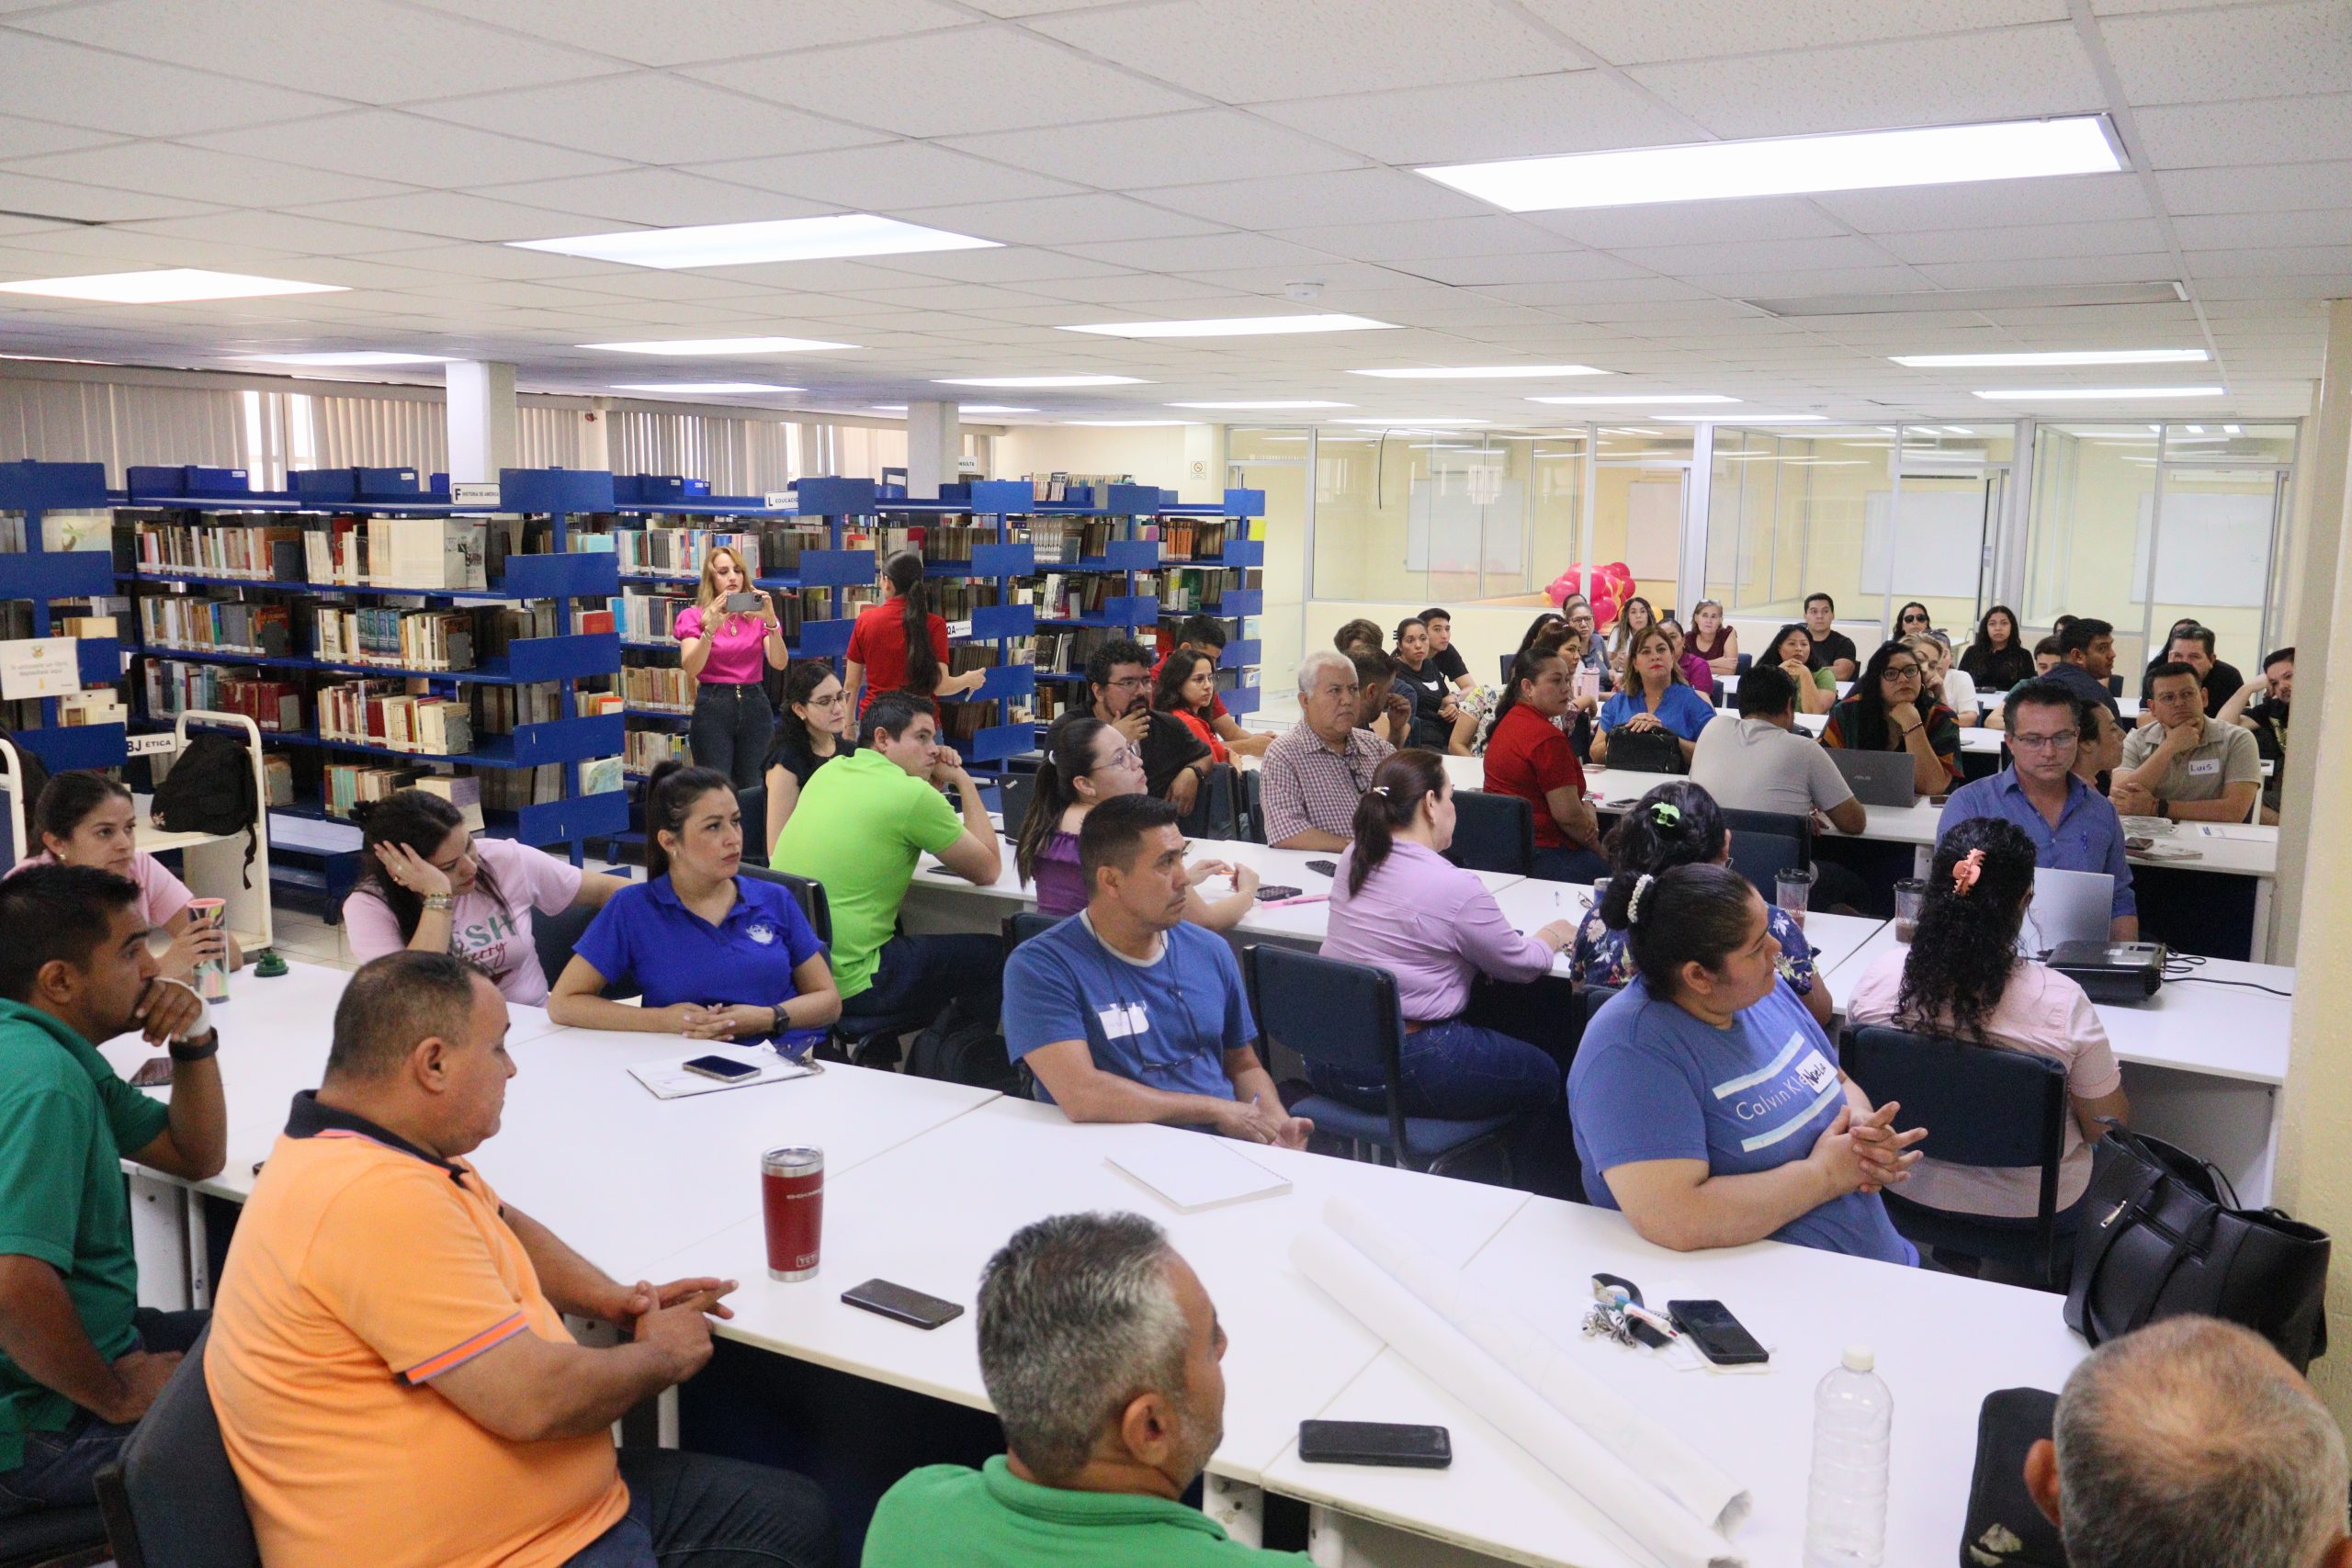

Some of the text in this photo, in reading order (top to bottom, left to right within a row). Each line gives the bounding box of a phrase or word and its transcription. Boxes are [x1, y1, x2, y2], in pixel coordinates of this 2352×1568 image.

[455, 488, 461, 501] F
[768, 496, 774, 506] L
[127, 739, 171, 752] BJ ETICA
[1736, 1089, 1791, 1121] Calvin
